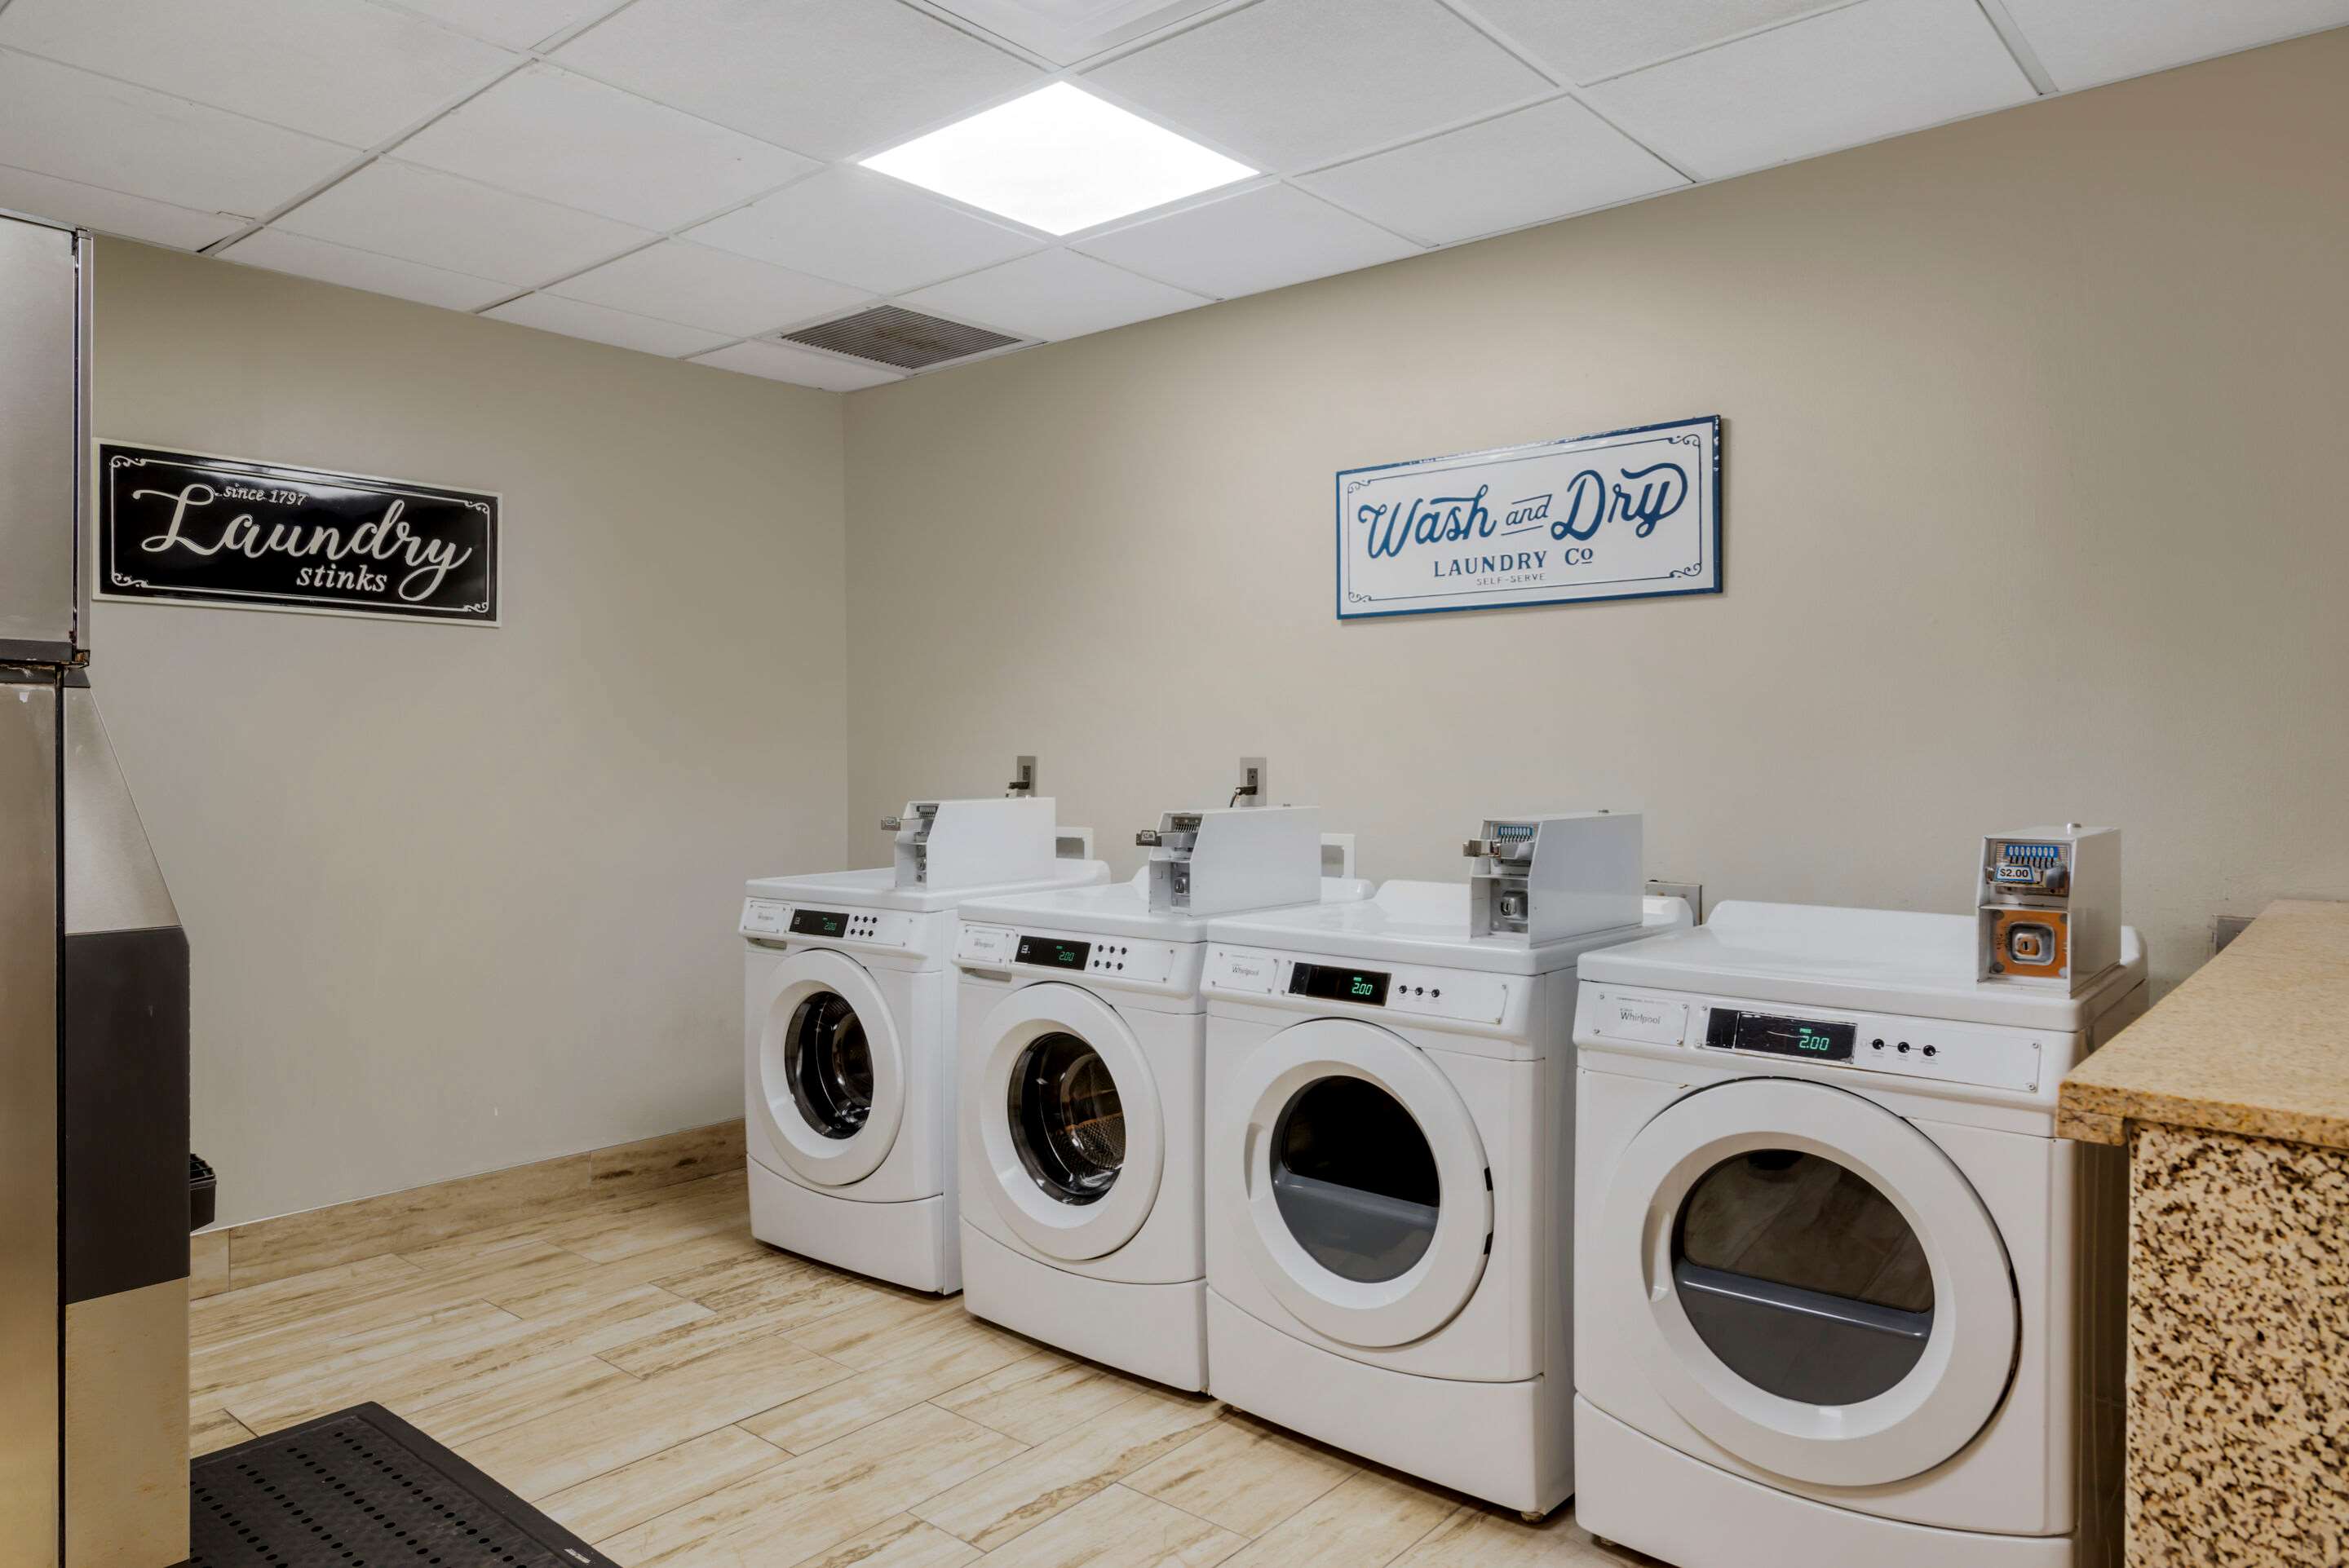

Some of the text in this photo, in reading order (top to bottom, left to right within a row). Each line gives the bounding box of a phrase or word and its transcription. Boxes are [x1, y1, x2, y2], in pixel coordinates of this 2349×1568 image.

[223, 483, 307, 506] since 1797
[1357, 462, 1688, 559] Wash and Dry
[131, 483, 472, 602] Laundry
[1434, 550, 1547, 577] LAUNDRY
[296, 564, 388, 593] stinks
[1476, 572, 1546, 586] SELF-SERVE
[1999, 868, 2029, 878] $2.00
[1351, 983, 1374, 996] 2.00
[1620, 1010, 1662, 1025] Whirlpool
[1799, 1036, 1830, 1051] 2.00
